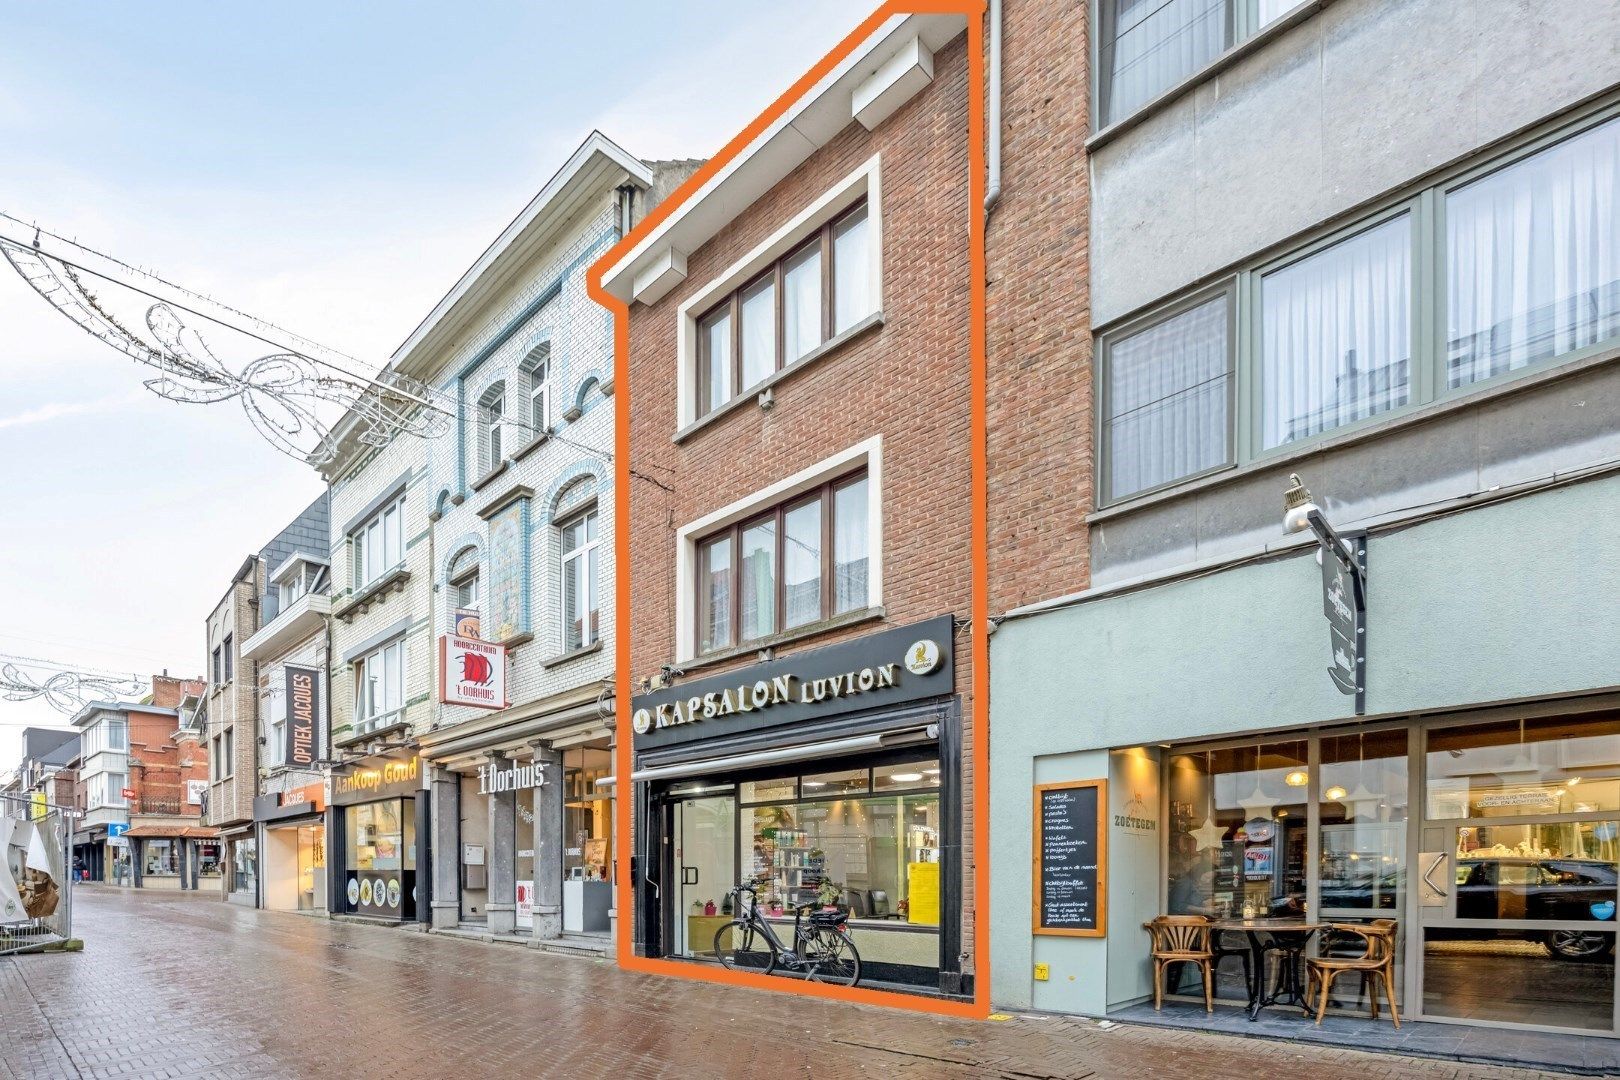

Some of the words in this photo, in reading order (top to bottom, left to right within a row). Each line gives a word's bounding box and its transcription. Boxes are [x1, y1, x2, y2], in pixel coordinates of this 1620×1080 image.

[293, 673, 312, 725] JACQUES
[463, 686, 495, 700] OORHUIS
[655, 674, 792, 729] KAPSALON
[801, 663, 895, 703] LUVION
[293, 726, 312, 763] OPTIEK
[335, 770, 381, 795] Aankoop
[384, 756, 417, 783] Goud
[489, 758, 544, 793] Oorhuis
